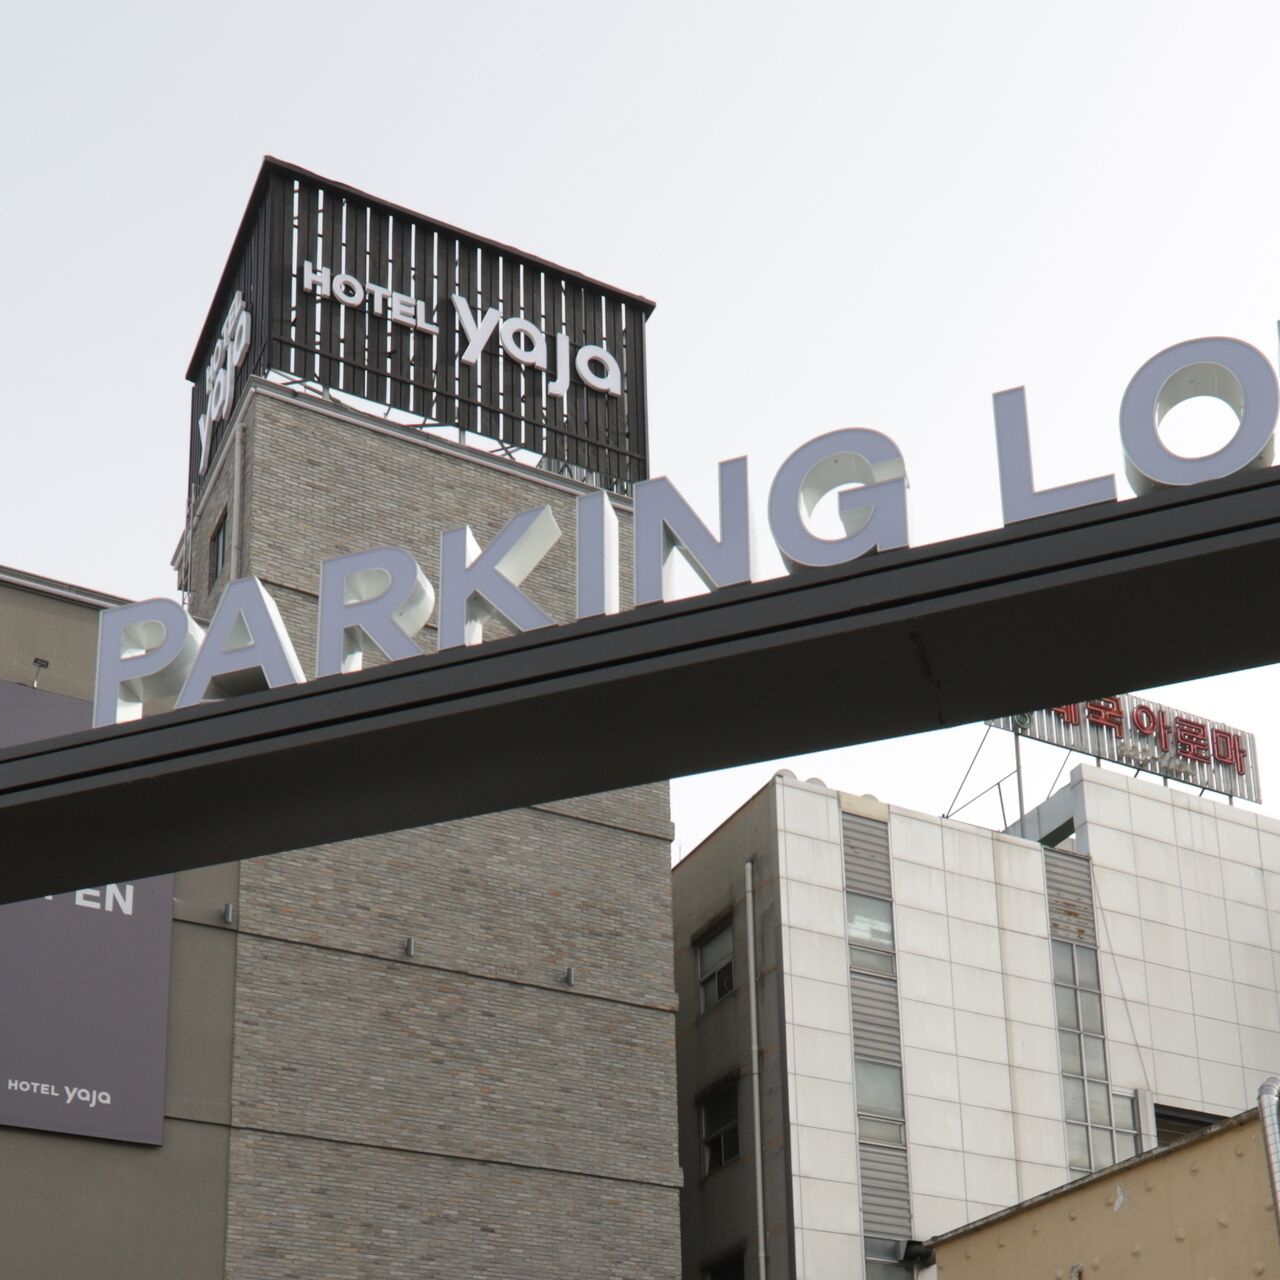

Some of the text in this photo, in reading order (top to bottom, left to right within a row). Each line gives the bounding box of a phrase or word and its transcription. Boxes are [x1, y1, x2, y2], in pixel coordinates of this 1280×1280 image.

[302, 259, 440, 335] HOTEL
[92, 426, 910, 729] PARKING
[45, 883, 135, 916] EN
[7, 1078, 59, 1097] HOTEL
